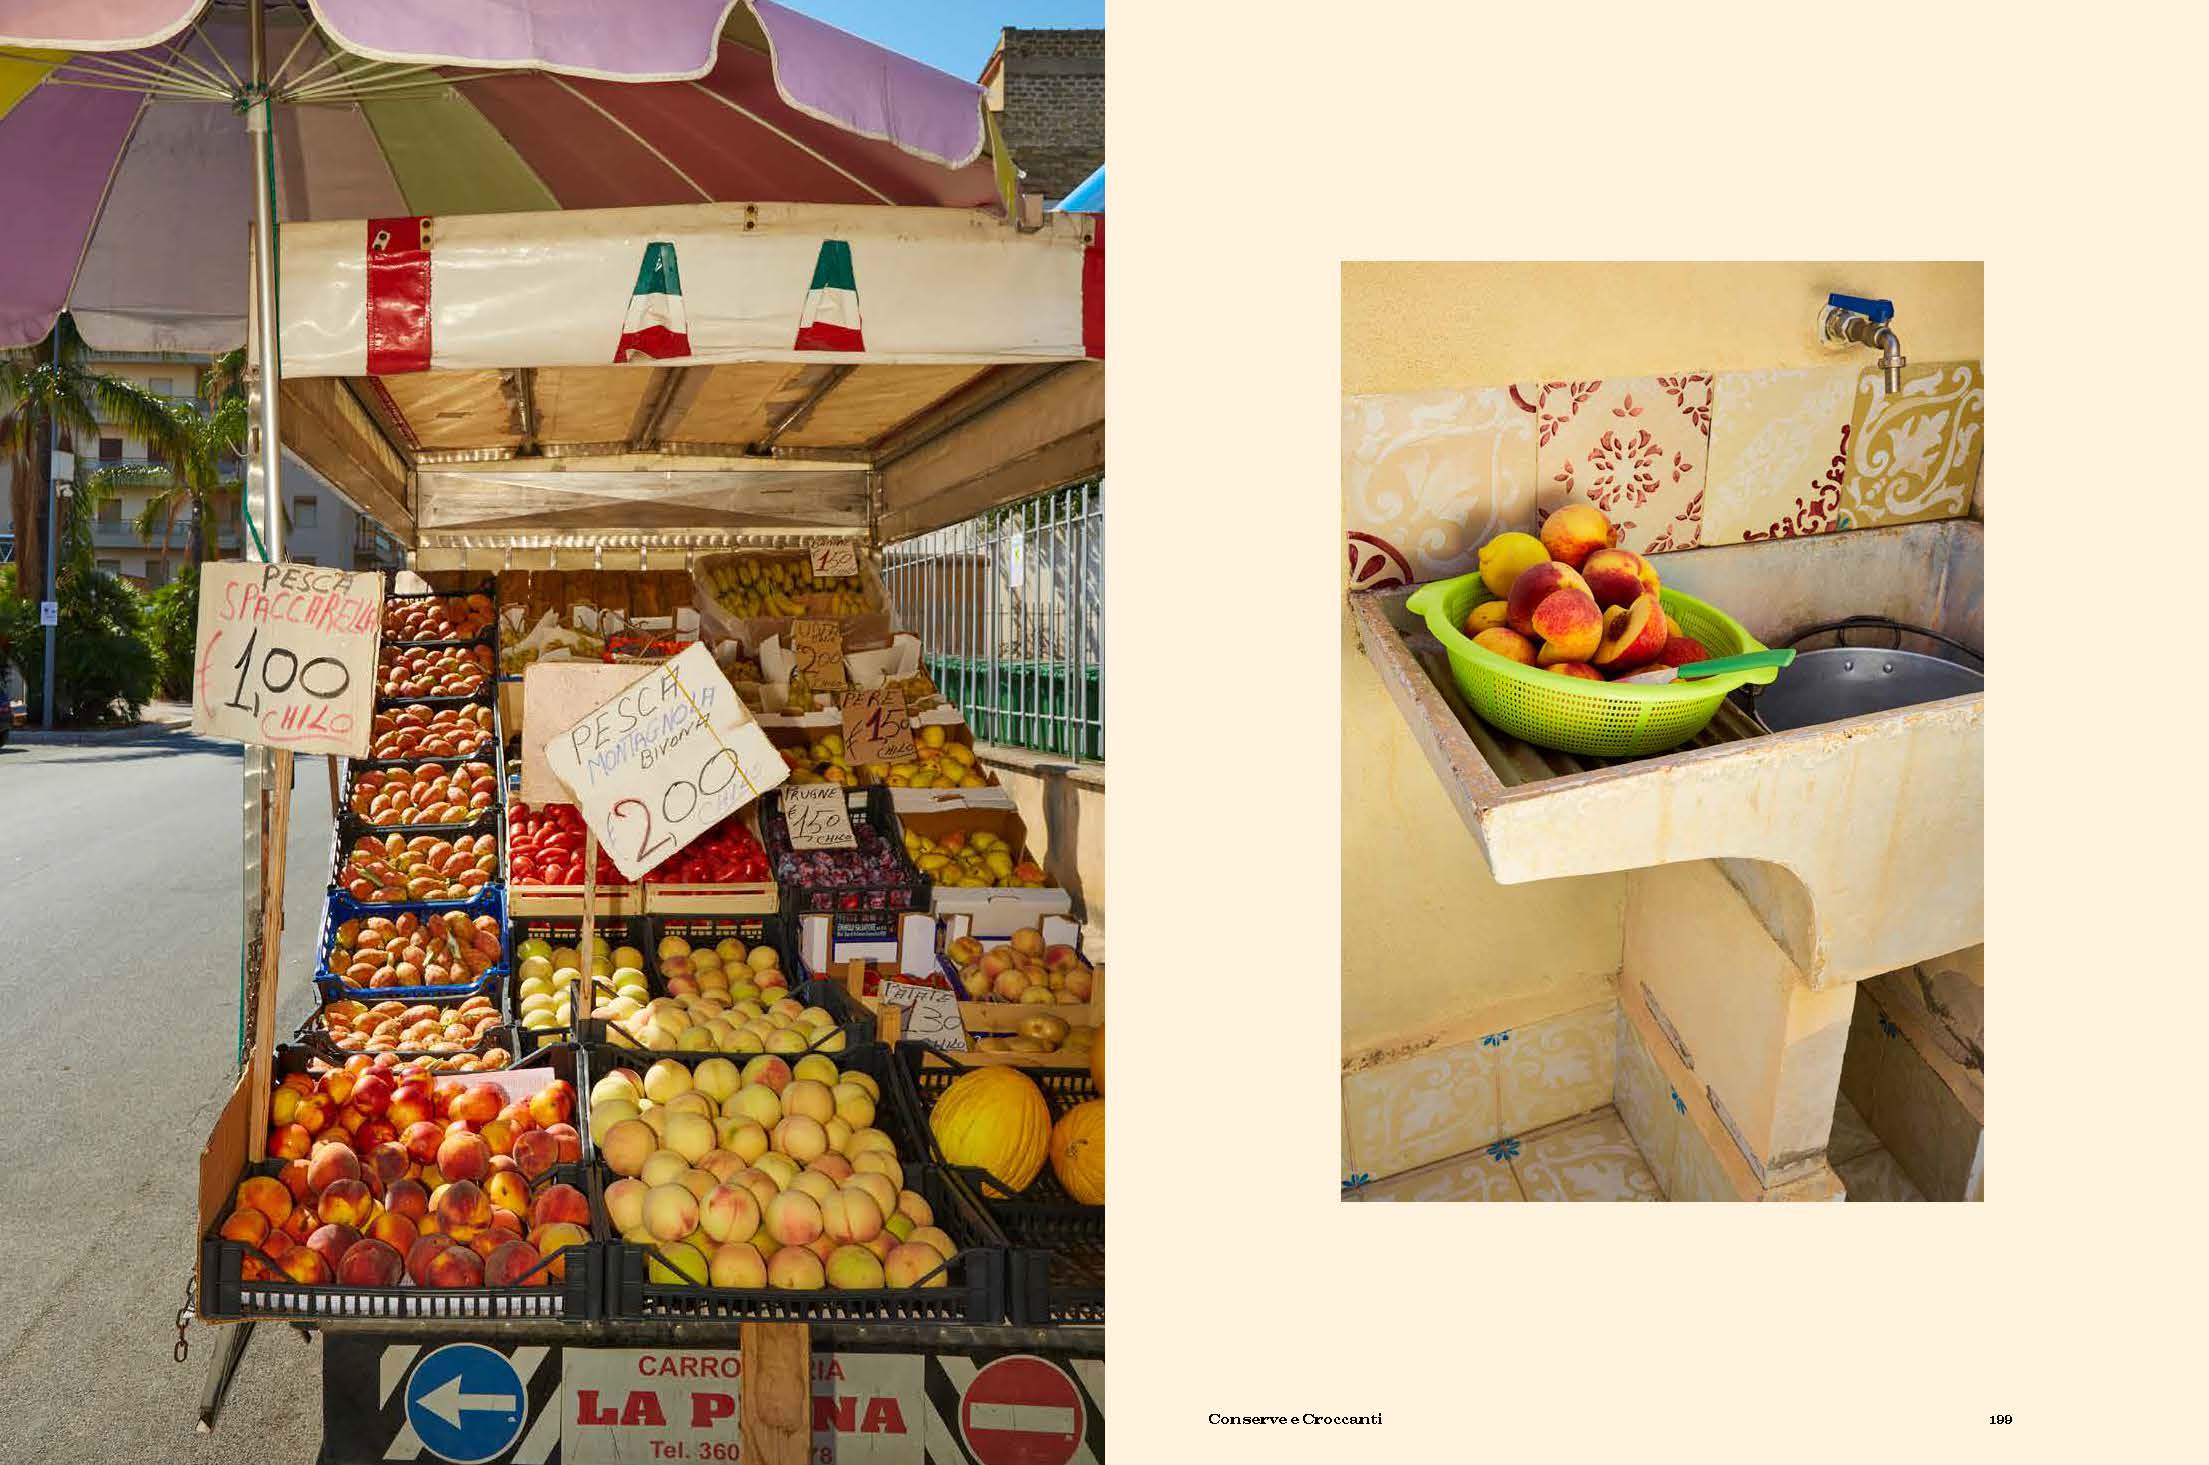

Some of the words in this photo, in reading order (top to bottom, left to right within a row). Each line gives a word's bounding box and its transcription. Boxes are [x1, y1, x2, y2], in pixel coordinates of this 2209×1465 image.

[263, 564, 353, 593] PESCA
[224, 626, 350, 718] 1,00
[570, 665, 681, 766] PESCA
[843, 690, 896, 707] PERE
[261, 704, 354, 741] CHILO
[576, 1389, 667, 1427] LA
[651, 1440, 690, 1460] Tel.
